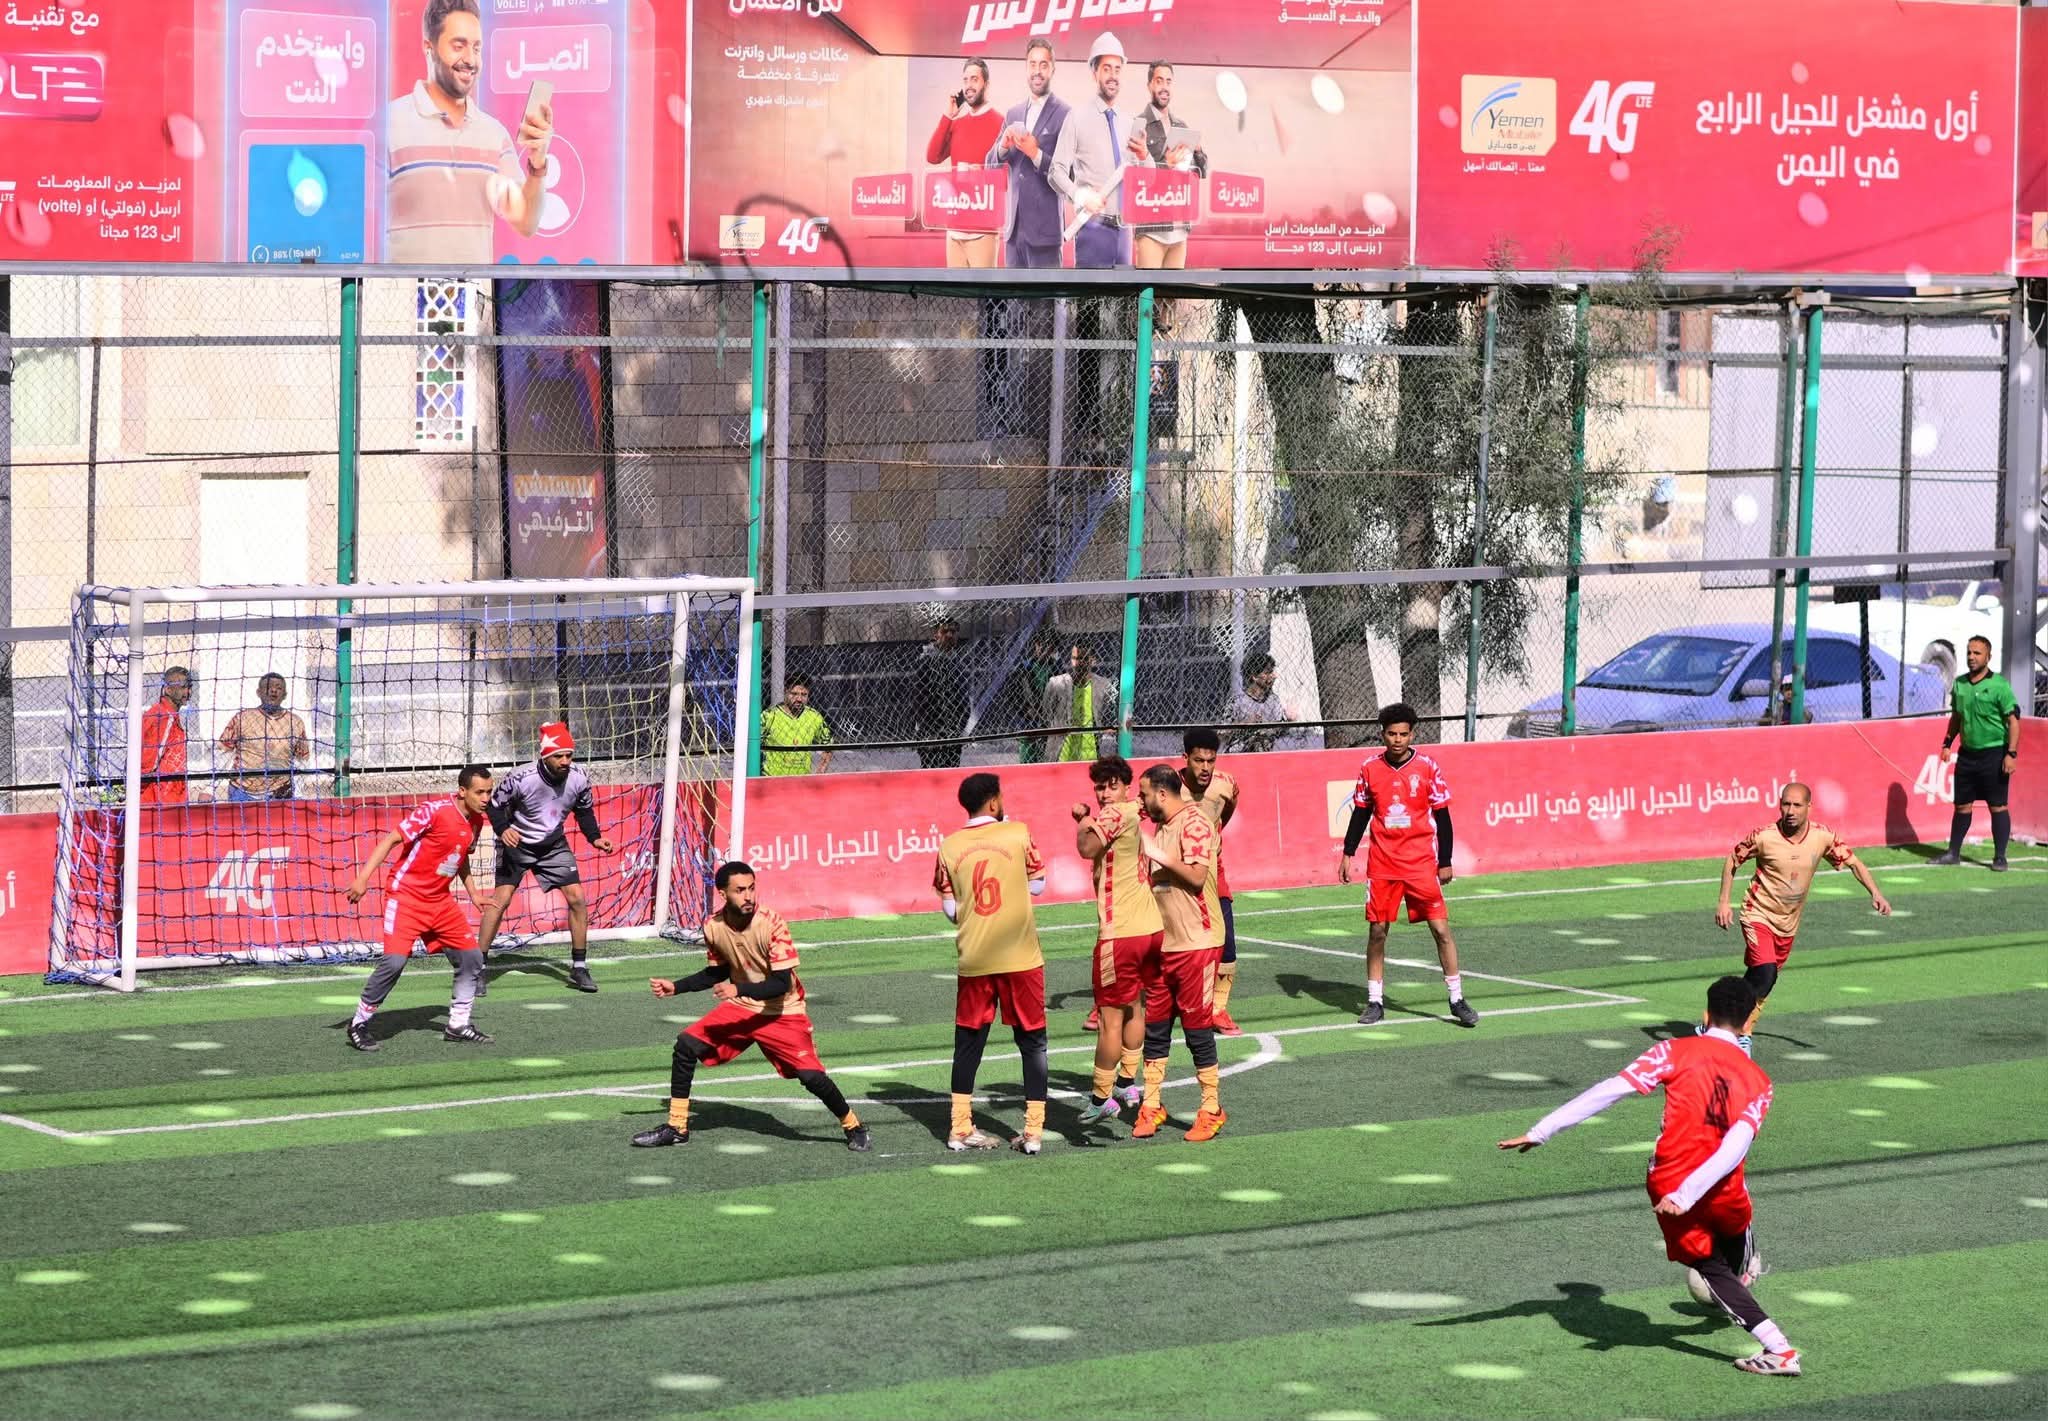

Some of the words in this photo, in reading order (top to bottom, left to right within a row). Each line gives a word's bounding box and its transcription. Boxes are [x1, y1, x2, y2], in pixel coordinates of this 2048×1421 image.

[5, 2, 65, 31] تقنية
[70, 10, 99, 35] مع
[256, 28, 365, 68] واستخدم
[506, 38, 589, 79] اتصل
[285, 75, 337, 104] النت
[1635, 95, 1653, 108] LTE
[1488, 108, 1544, 130] Yemen
[1569, 80, 1655, 153] 4G
[1695, 91, 1762, 135] الرابع
[1770, 94, 1838, 135] للجيل
[1846, 93, 1927, 137] مشغل
[1934, 90, 1979, 142] أول
[1776, 145, 1847, 186] اليمن
[1853, 148, 1900, 187] في
[37, 174, 111, 192] المعلومات
[114, 179, 134, 193] من
[137, 177, 181, 194] لمزيد
[1135, 180, 1191, 213] الفضية
[38, 198, 81, 215] (volte)
[101, 199, 146, 219] (فولتي)
[932, 184, 995, 216] الذهبية
[133, 224, 158, 239] 123
[161, 225, 181, 243] إلى
[777, 216, 830, 255] 4G
[1290, 223, 1337, 237] المعلومات
[1307, 240, 1325, 253] 123
[1338, 225, 1352, 237] من
[1354, 223, 1386, 237] لمزيد
[1326, 240, 1341, 255] إلى
[1485, 792, 1539, 827] اليمن
[1544, 790, 1581, 822] في
[1587, 786, 1636, 820] الرابع
[1641, 783, 1692, 816] للجيل
[1698, 776, 1760, 813] مشغل
[747, 834, 809, 873] الرابع
[817, 830, 879, 867] للجيل
[887, 823, 944, 863] شغل
[204, 846, 291, 913] 4G
[972, 858, 1002, 917] 6
